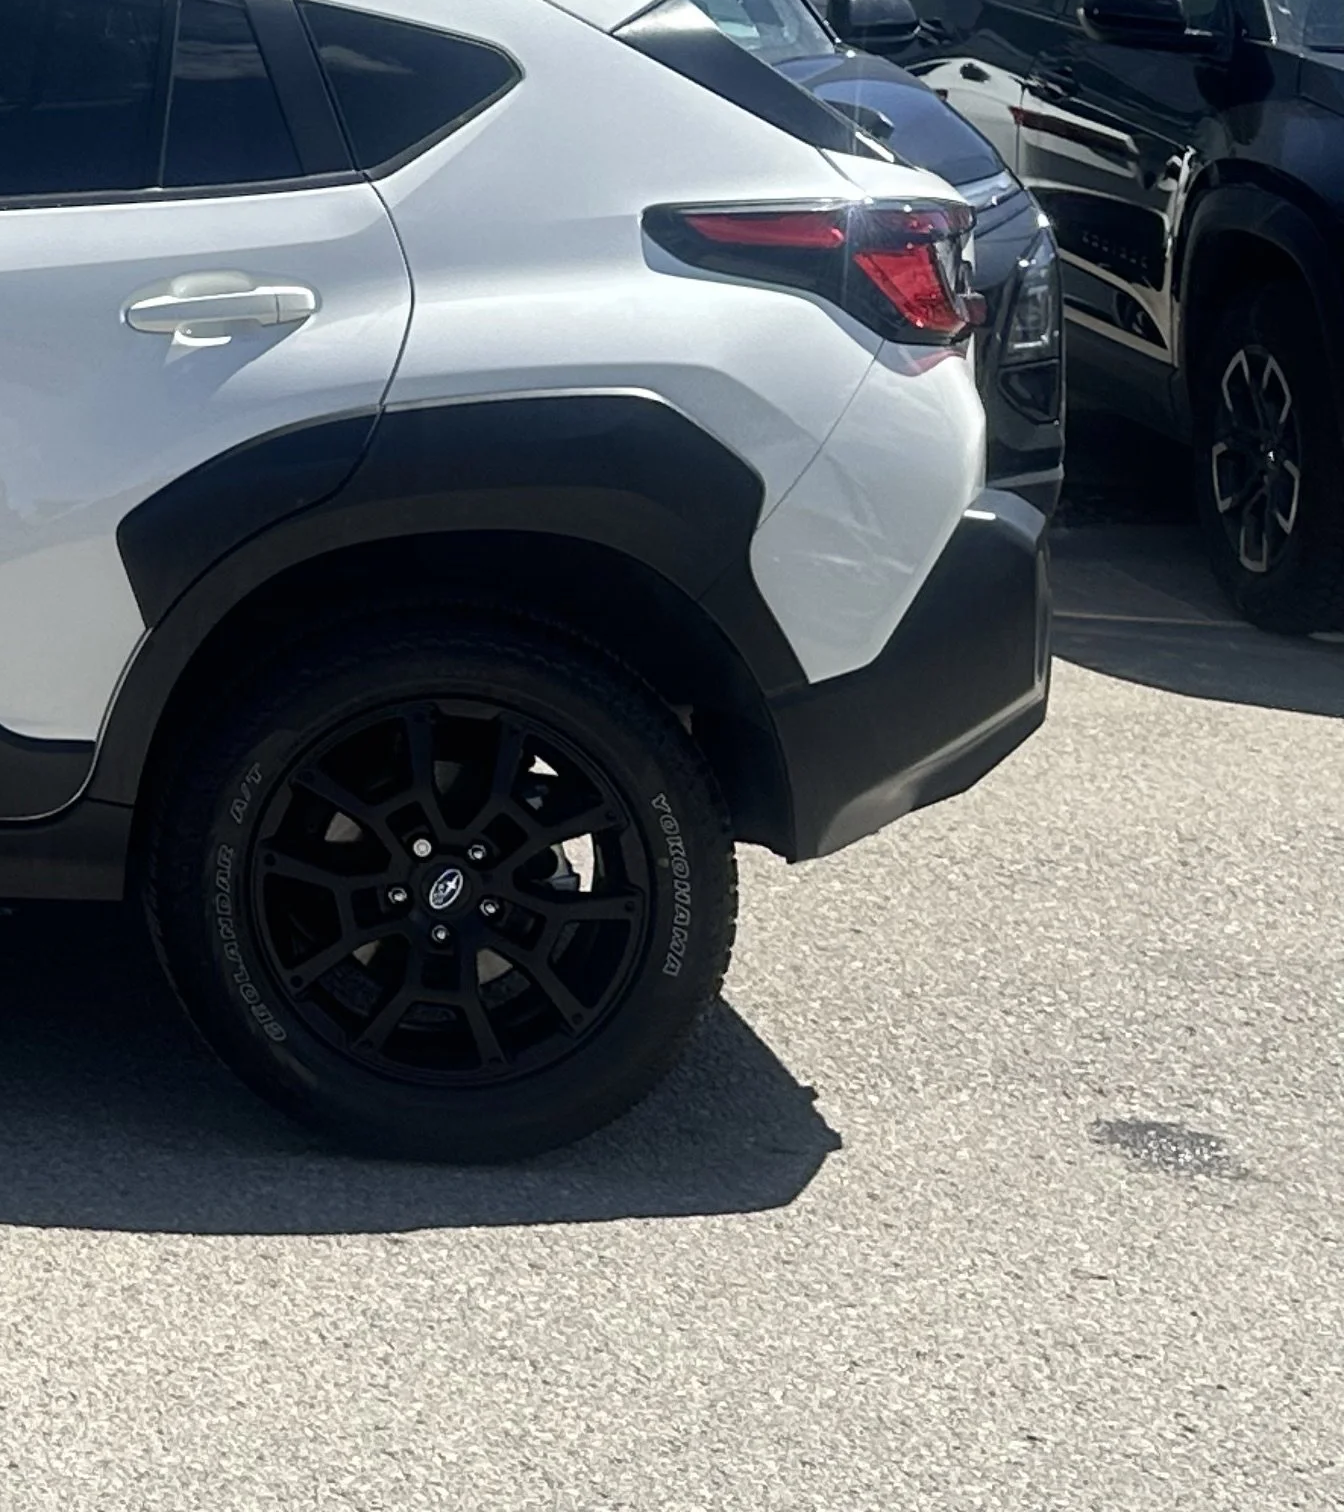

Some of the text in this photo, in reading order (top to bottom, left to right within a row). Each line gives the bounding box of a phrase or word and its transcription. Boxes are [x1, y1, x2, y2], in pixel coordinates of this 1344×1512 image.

[215, 761, 287, 1044] GEOLANDAR A/T
[650, 791, 694, 977] YOKOHAMA
